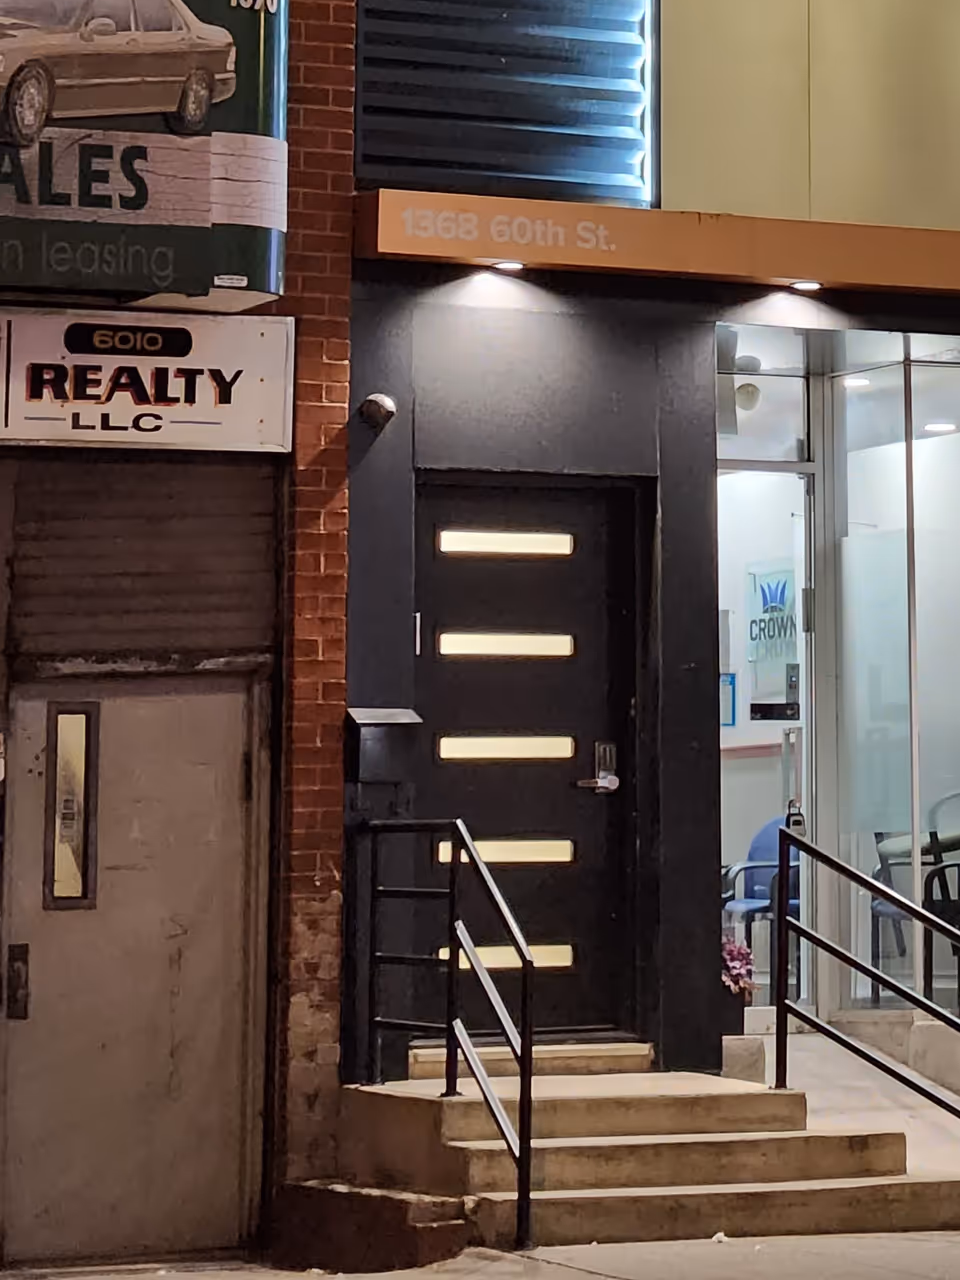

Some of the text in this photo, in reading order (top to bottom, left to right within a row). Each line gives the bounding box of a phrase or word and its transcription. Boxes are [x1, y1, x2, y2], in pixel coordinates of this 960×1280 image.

[402, 206, 617, 251] 1368 60th St.
[42, 228, 174, 288] leasing
[93, 330, 163, 351] 6010
[26, 362, 244, 409] REALTY
[71, 412, 164, 433] LLC
[749, 613, 797, 642] CROWN
